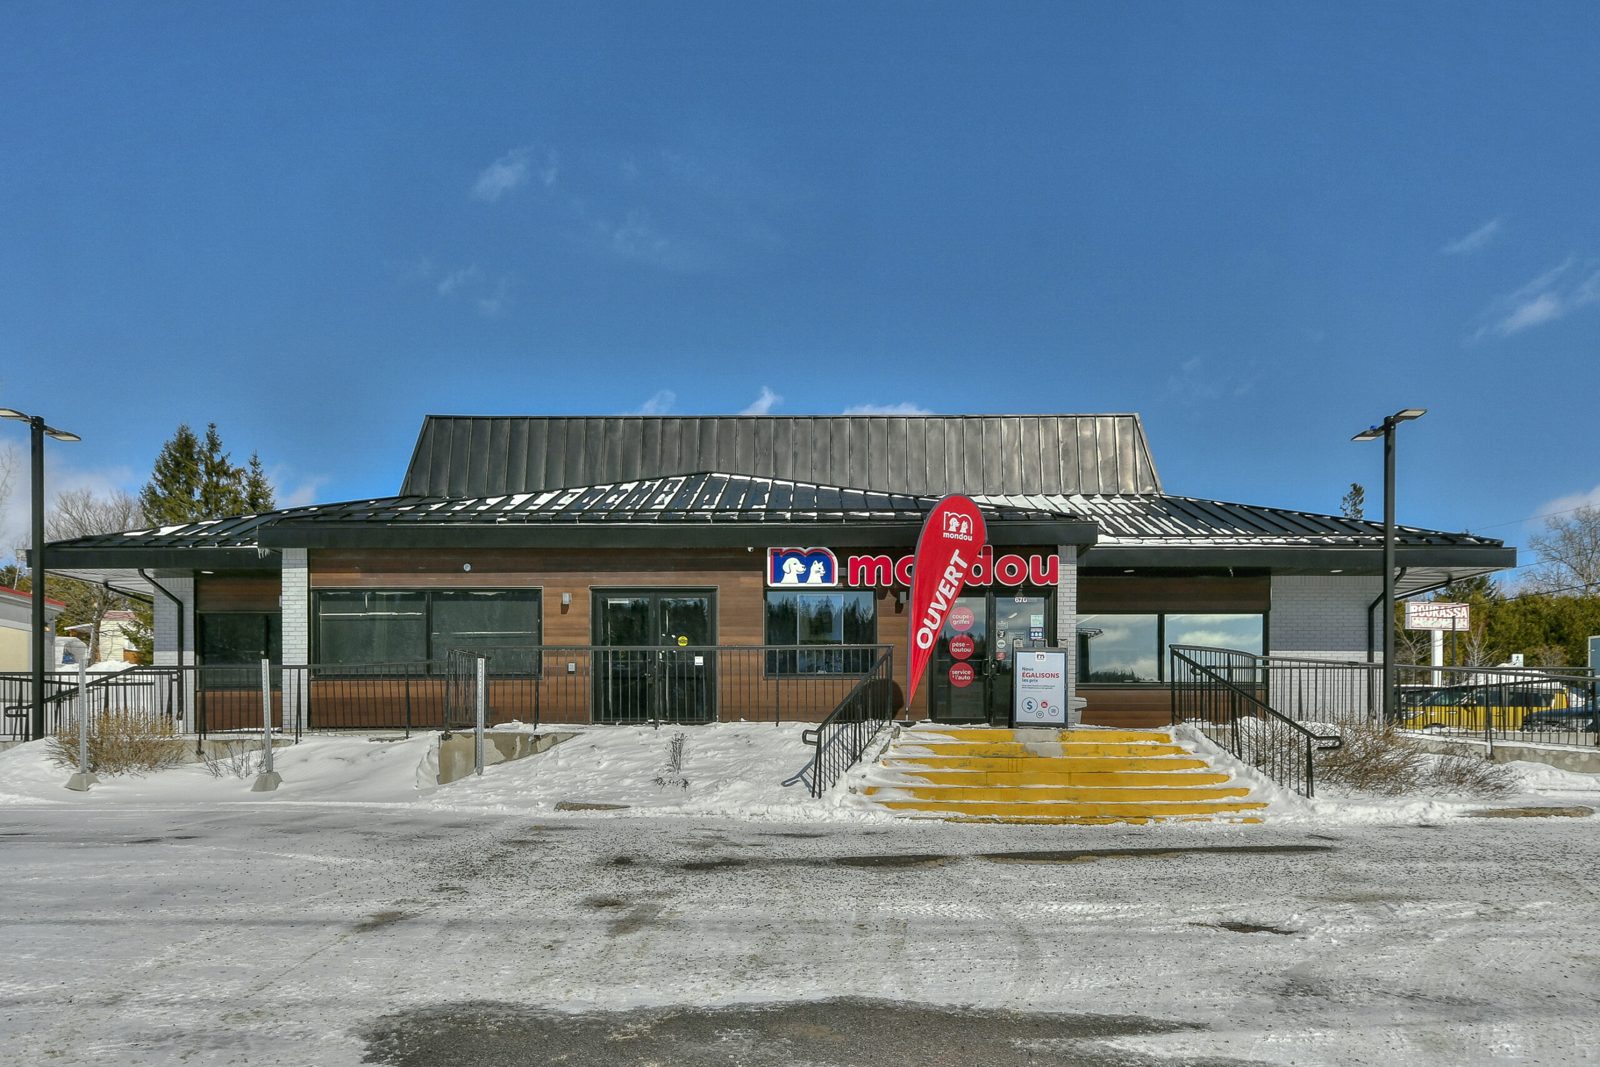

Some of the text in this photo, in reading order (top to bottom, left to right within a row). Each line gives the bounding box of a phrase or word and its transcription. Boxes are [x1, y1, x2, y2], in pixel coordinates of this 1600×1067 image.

[943, 532, 973, 541] mondou
[848, 545, 1060, 586] modou
[916, 549, 968, 649] OUVERT
[1410, 605, 1468, 618] BOURASSA
